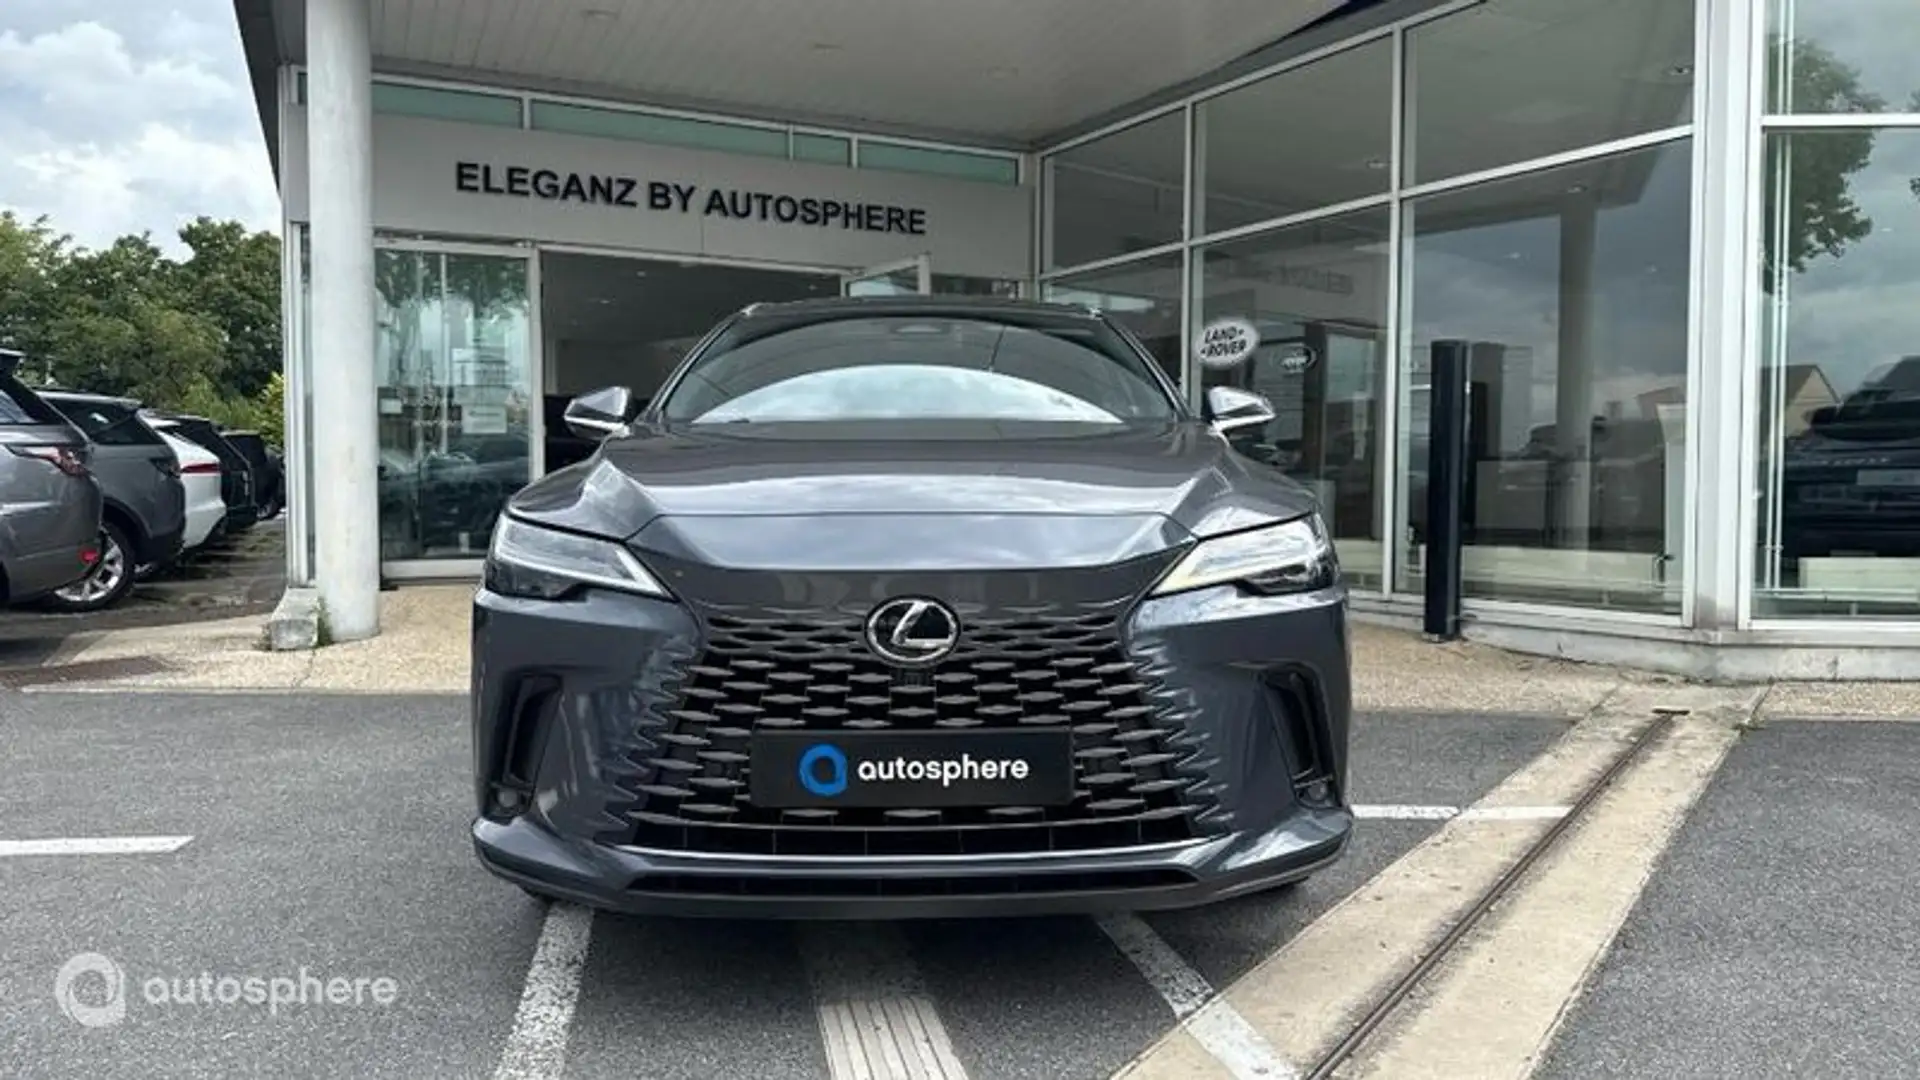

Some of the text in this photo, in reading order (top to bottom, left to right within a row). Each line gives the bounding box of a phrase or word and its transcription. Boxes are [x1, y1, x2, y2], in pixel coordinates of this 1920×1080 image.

[456, 162, 926, 235] ELEGANZ BY AUTOSPHERE
[857, 754, 1029, 786] autosphere
